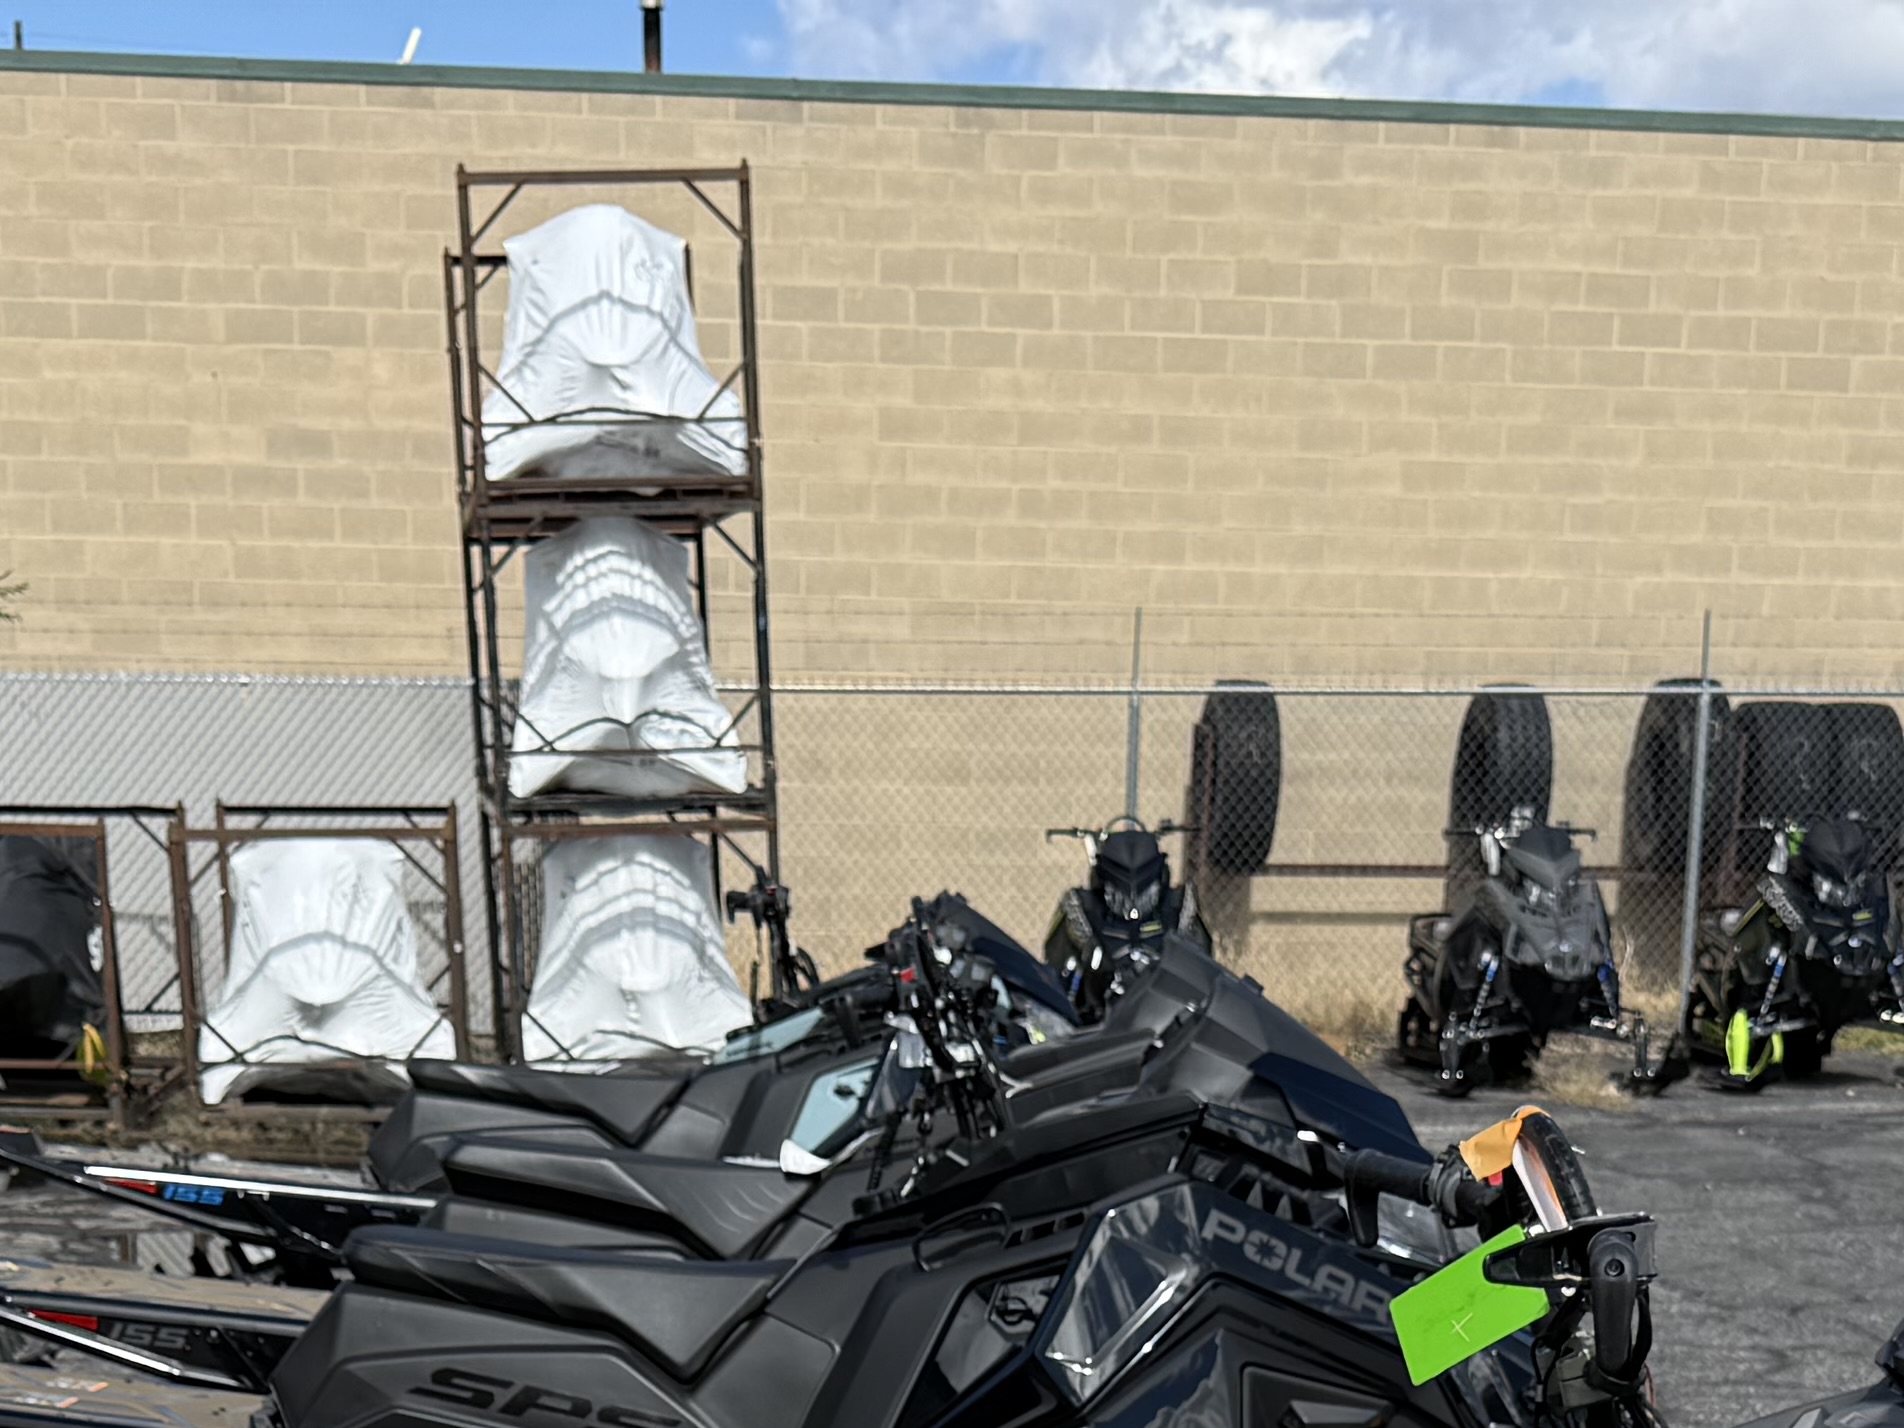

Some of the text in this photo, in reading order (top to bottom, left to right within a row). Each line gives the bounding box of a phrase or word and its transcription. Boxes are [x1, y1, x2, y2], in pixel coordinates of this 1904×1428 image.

[163, 1182, 226, 1206] 155
[1201, 1208, 1394, 1326] POLAR
[109, 1321, 189, 1349] 155
